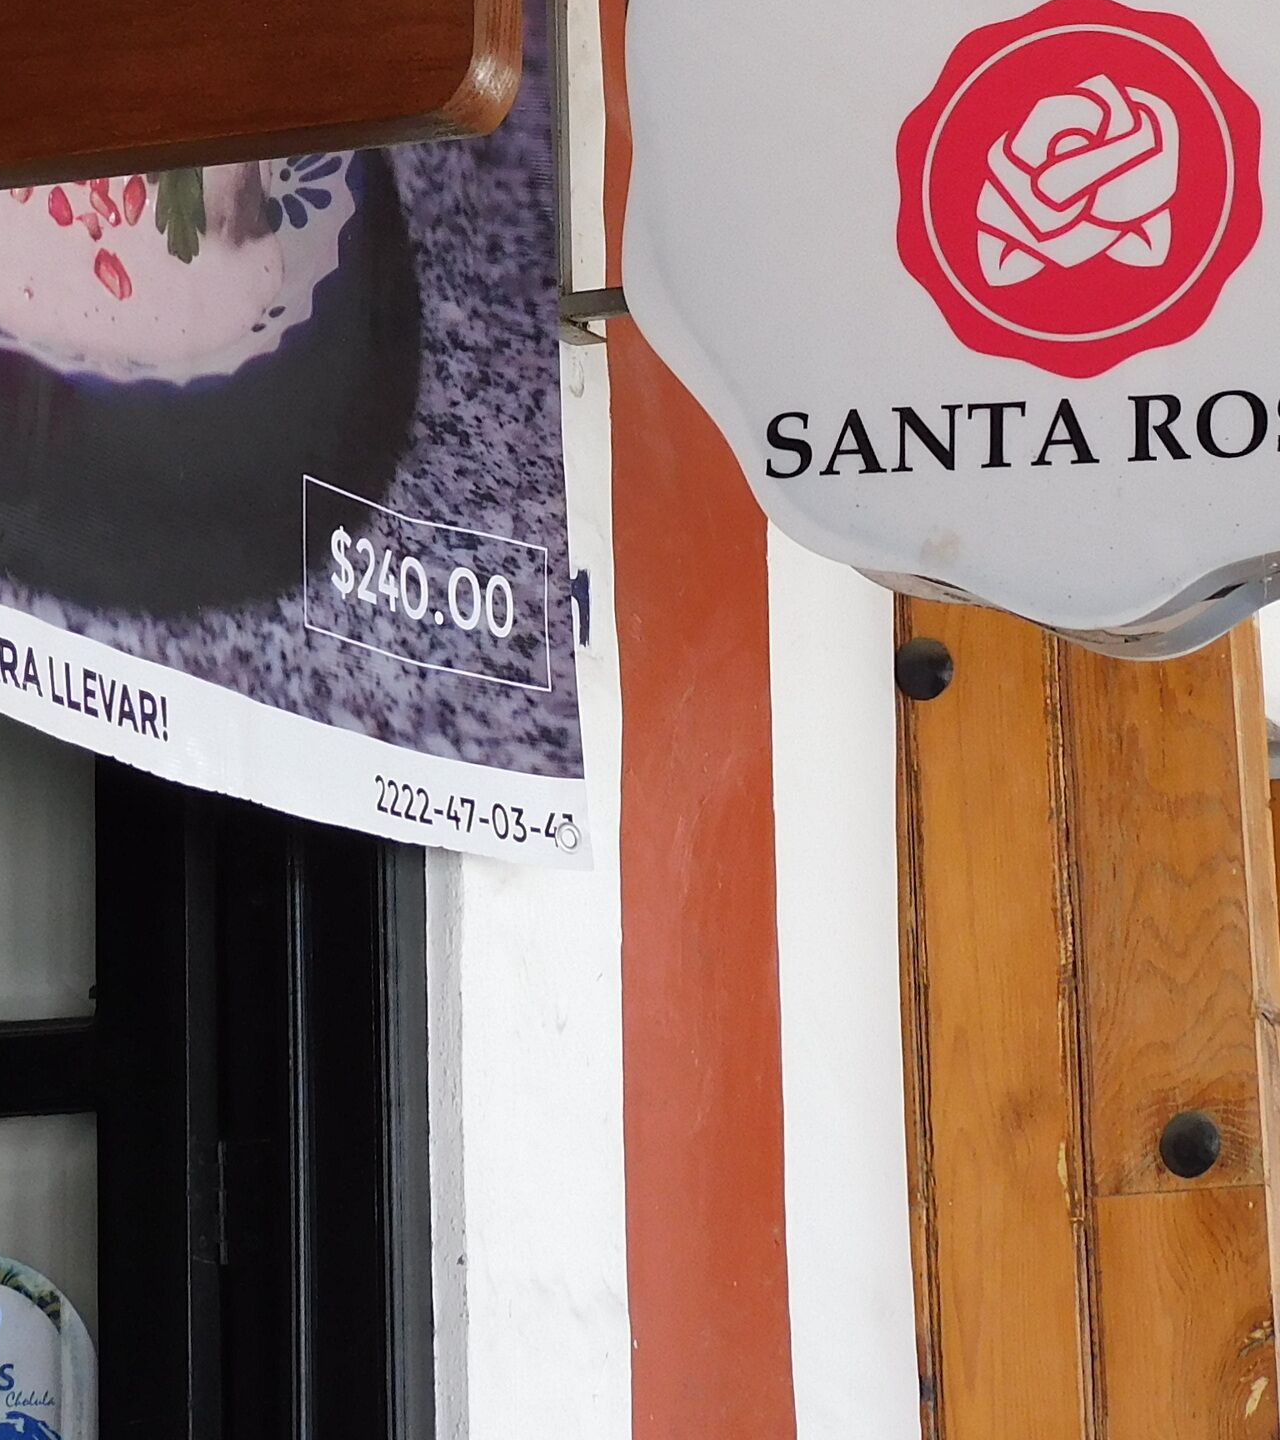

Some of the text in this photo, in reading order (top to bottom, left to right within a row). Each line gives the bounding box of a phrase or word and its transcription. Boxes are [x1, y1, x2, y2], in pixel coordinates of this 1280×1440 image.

[764, 398, 1101, 480] SANTA
[331, 526, 514, 638] $240.00
[49, 656, 169, 742] LLEVAR!
[6, 1391, 56, 1408] Cholula
